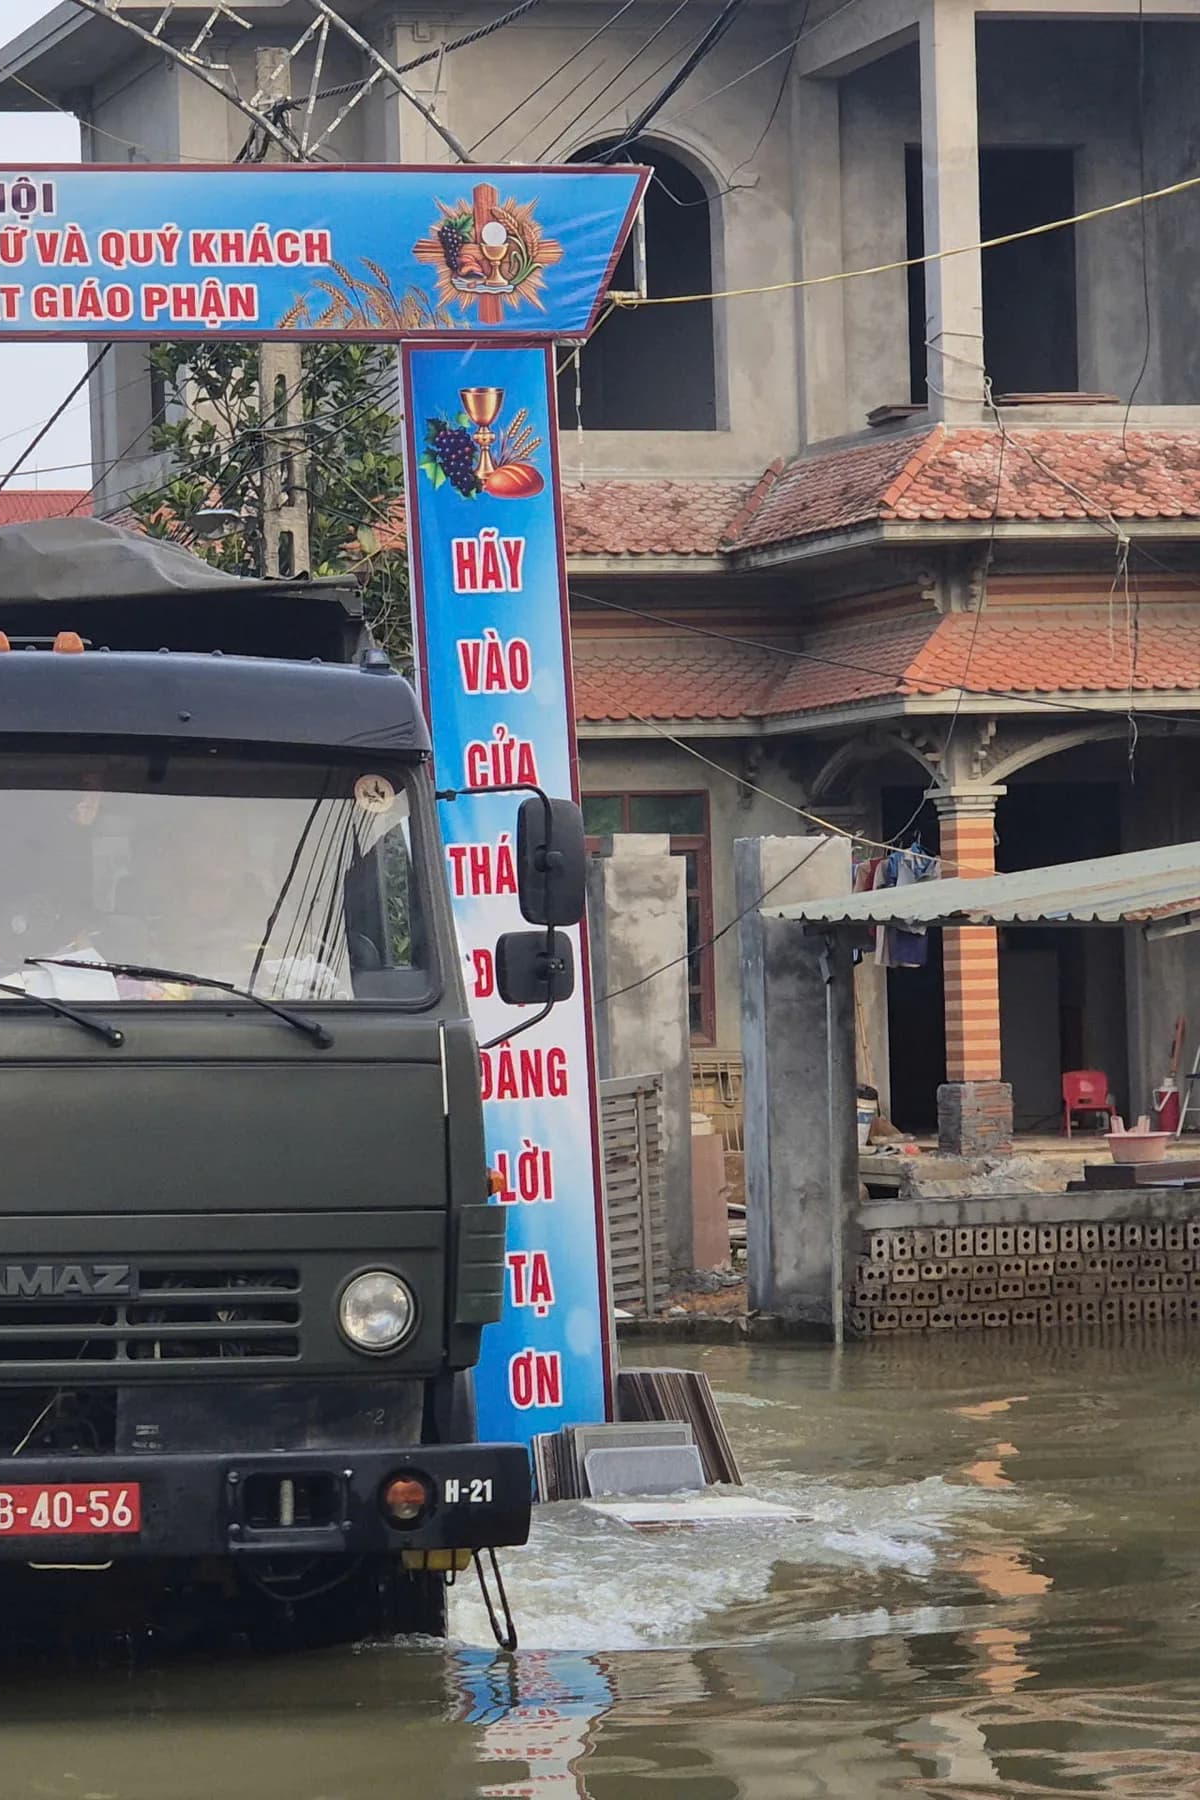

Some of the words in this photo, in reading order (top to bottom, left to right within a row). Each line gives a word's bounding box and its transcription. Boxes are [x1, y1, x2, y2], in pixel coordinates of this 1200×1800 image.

[36, 226, 88, 263] VÀ
[102, 226, 179, 266] QUÝ
[193, 226, 330, 264] KHÁCH
[33, 280, 131, 319] GIÁO
[144, 280, 256, 325] PHẬN
[454, 531, 523, 590] HÃY
[460, 631, 531, 691] VÀO
[467, 726, 538, 788] CỬA
[449, 834, 518, 896] THÁ
[497, 1139, 553, 1203] LỜI
[509, 1253, 553, 1316] TẠ
[512, 1349, 560, 1407] ƠN
[444, 1479, 493, 1503] H-21
